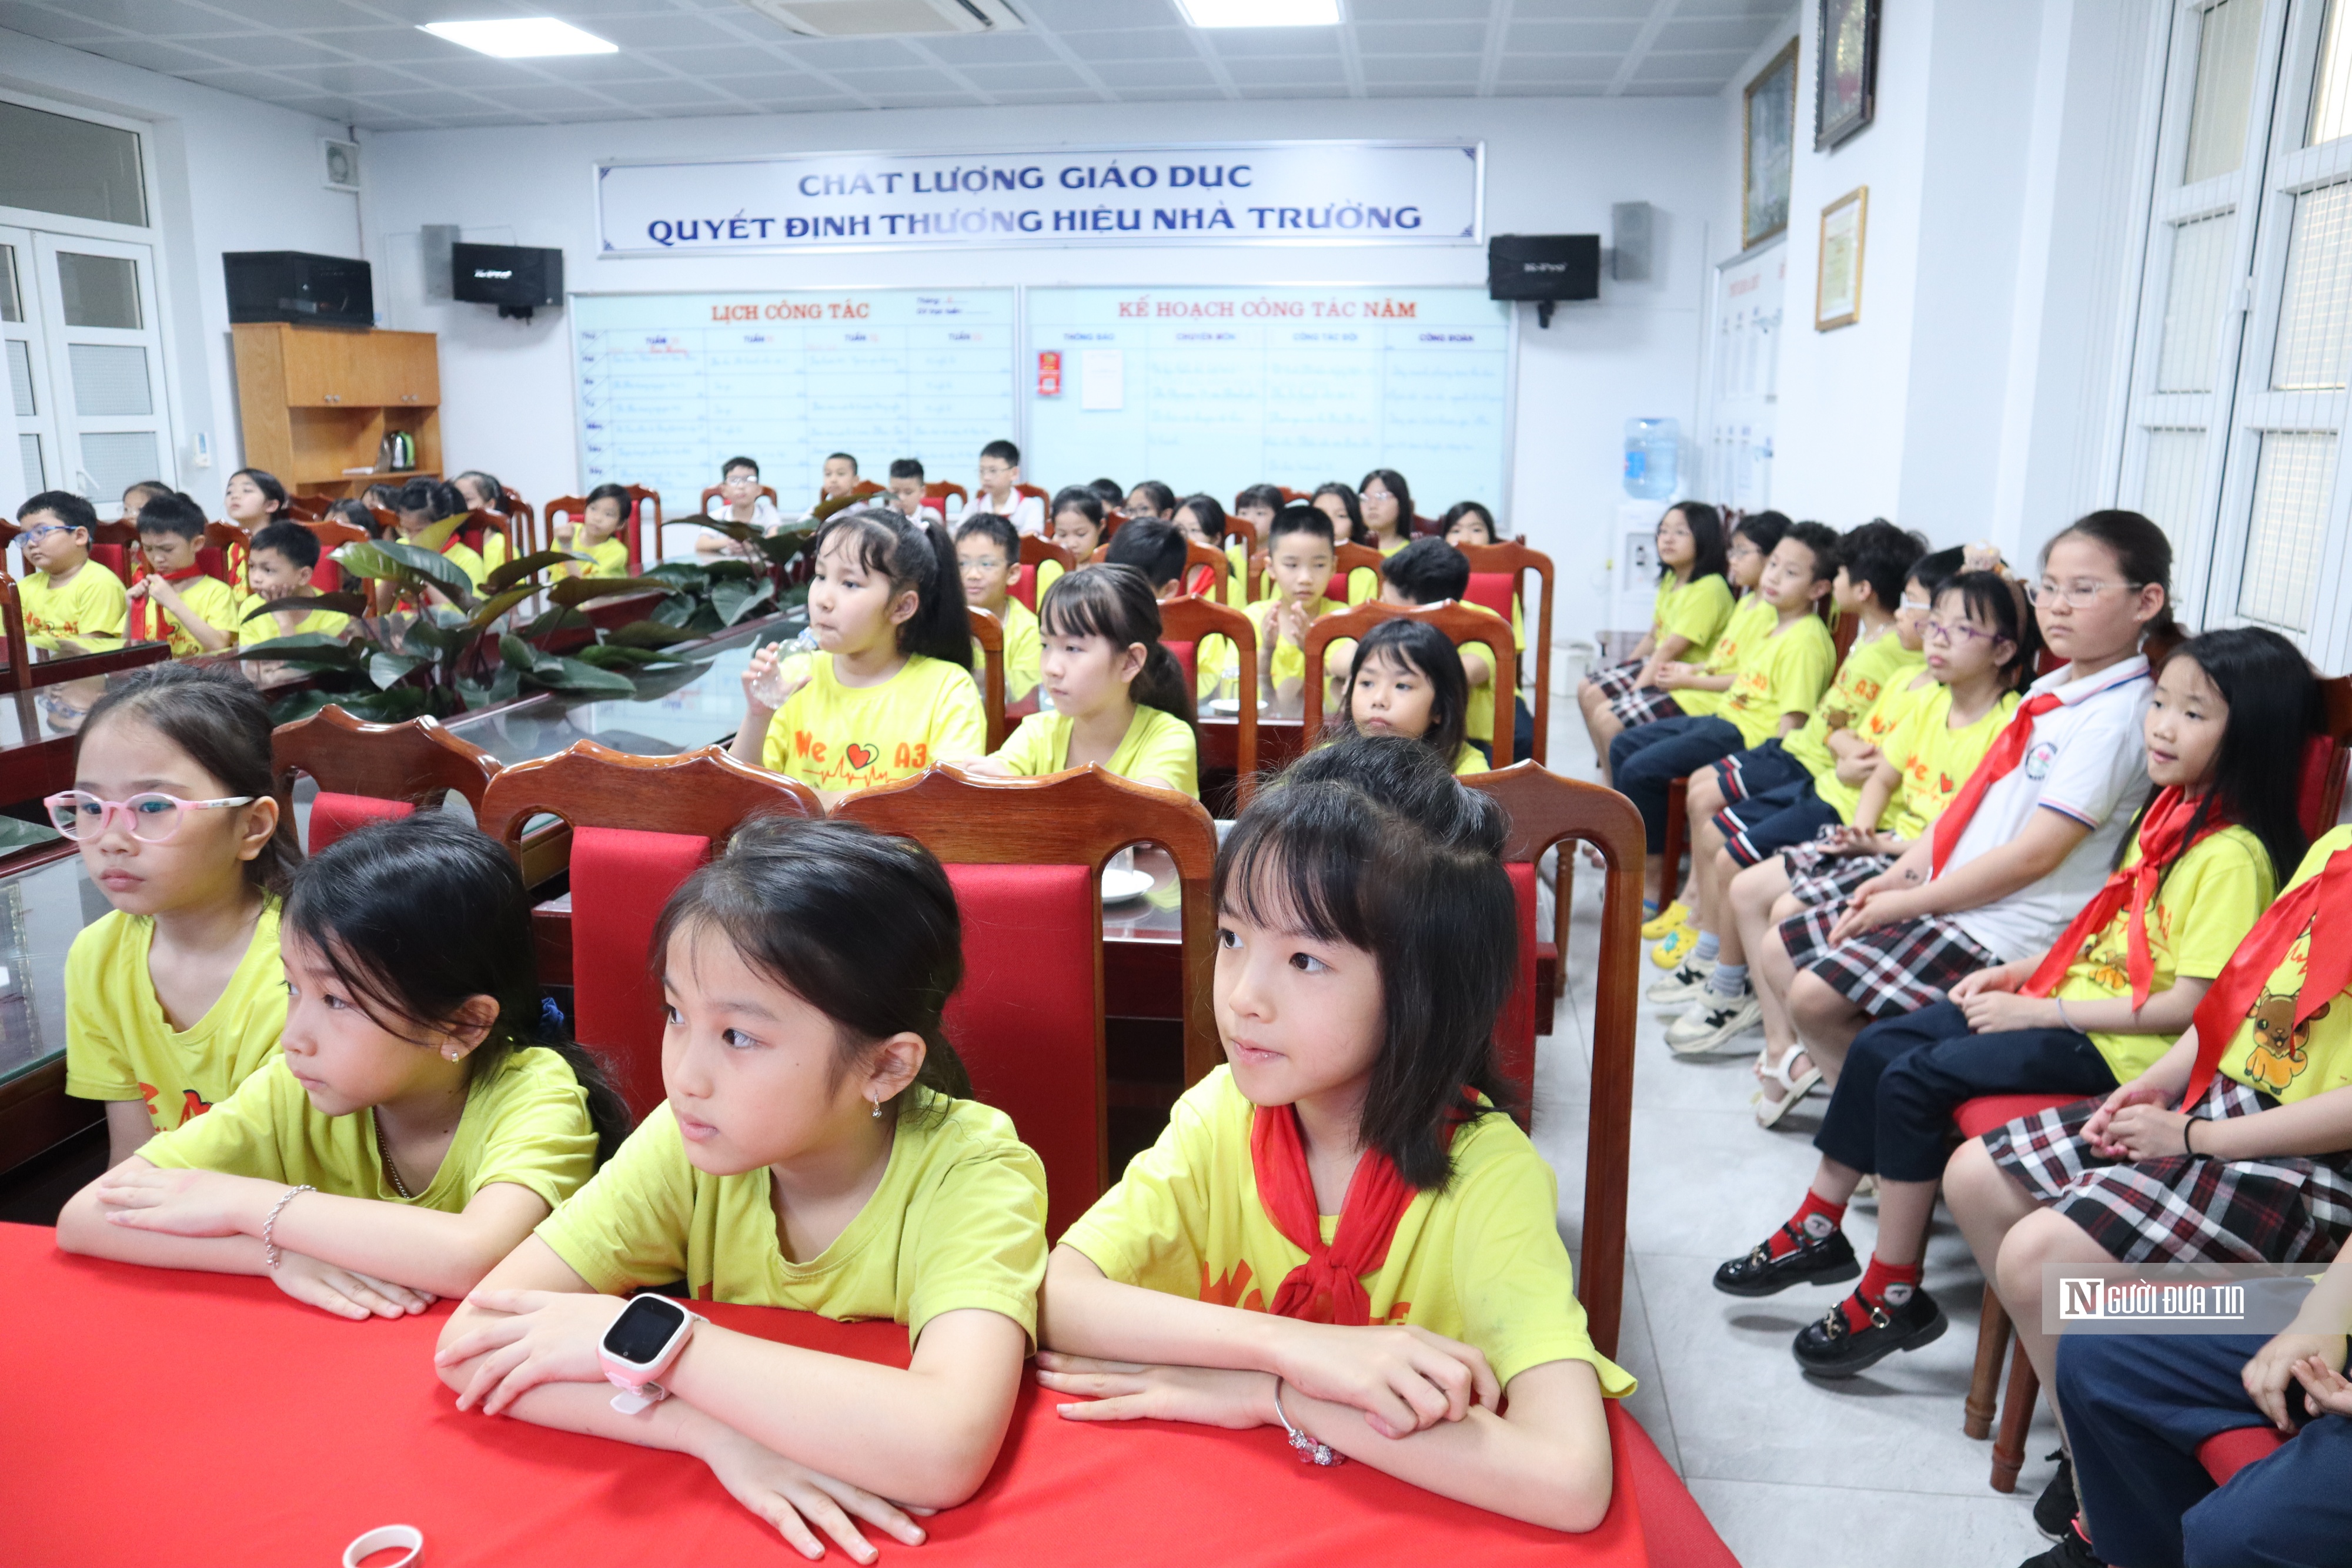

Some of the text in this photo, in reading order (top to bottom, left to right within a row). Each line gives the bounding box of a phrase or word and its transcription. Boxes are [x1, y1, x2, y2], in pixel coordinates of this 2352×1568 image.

[913, 166, 1044, 194] LƯỢNG
[1060, 159, 1157, 189] GIÁO
[1168, 165, 1252, 190] DỤC
[648, 198, 1422, 246] QUYẾT ĐỊNH THƯƠNG HIỆU NHÀ TRƯỜNG
[711, 299, 869, 325] LỊCH CÔNG TÁC
[1119, 294, 1417, 321] KẾ HOẠCH CÔNG TÁC NĂM
[1854, 678, 1881, 701] A3
[794, 730, 927, 768] We A3
